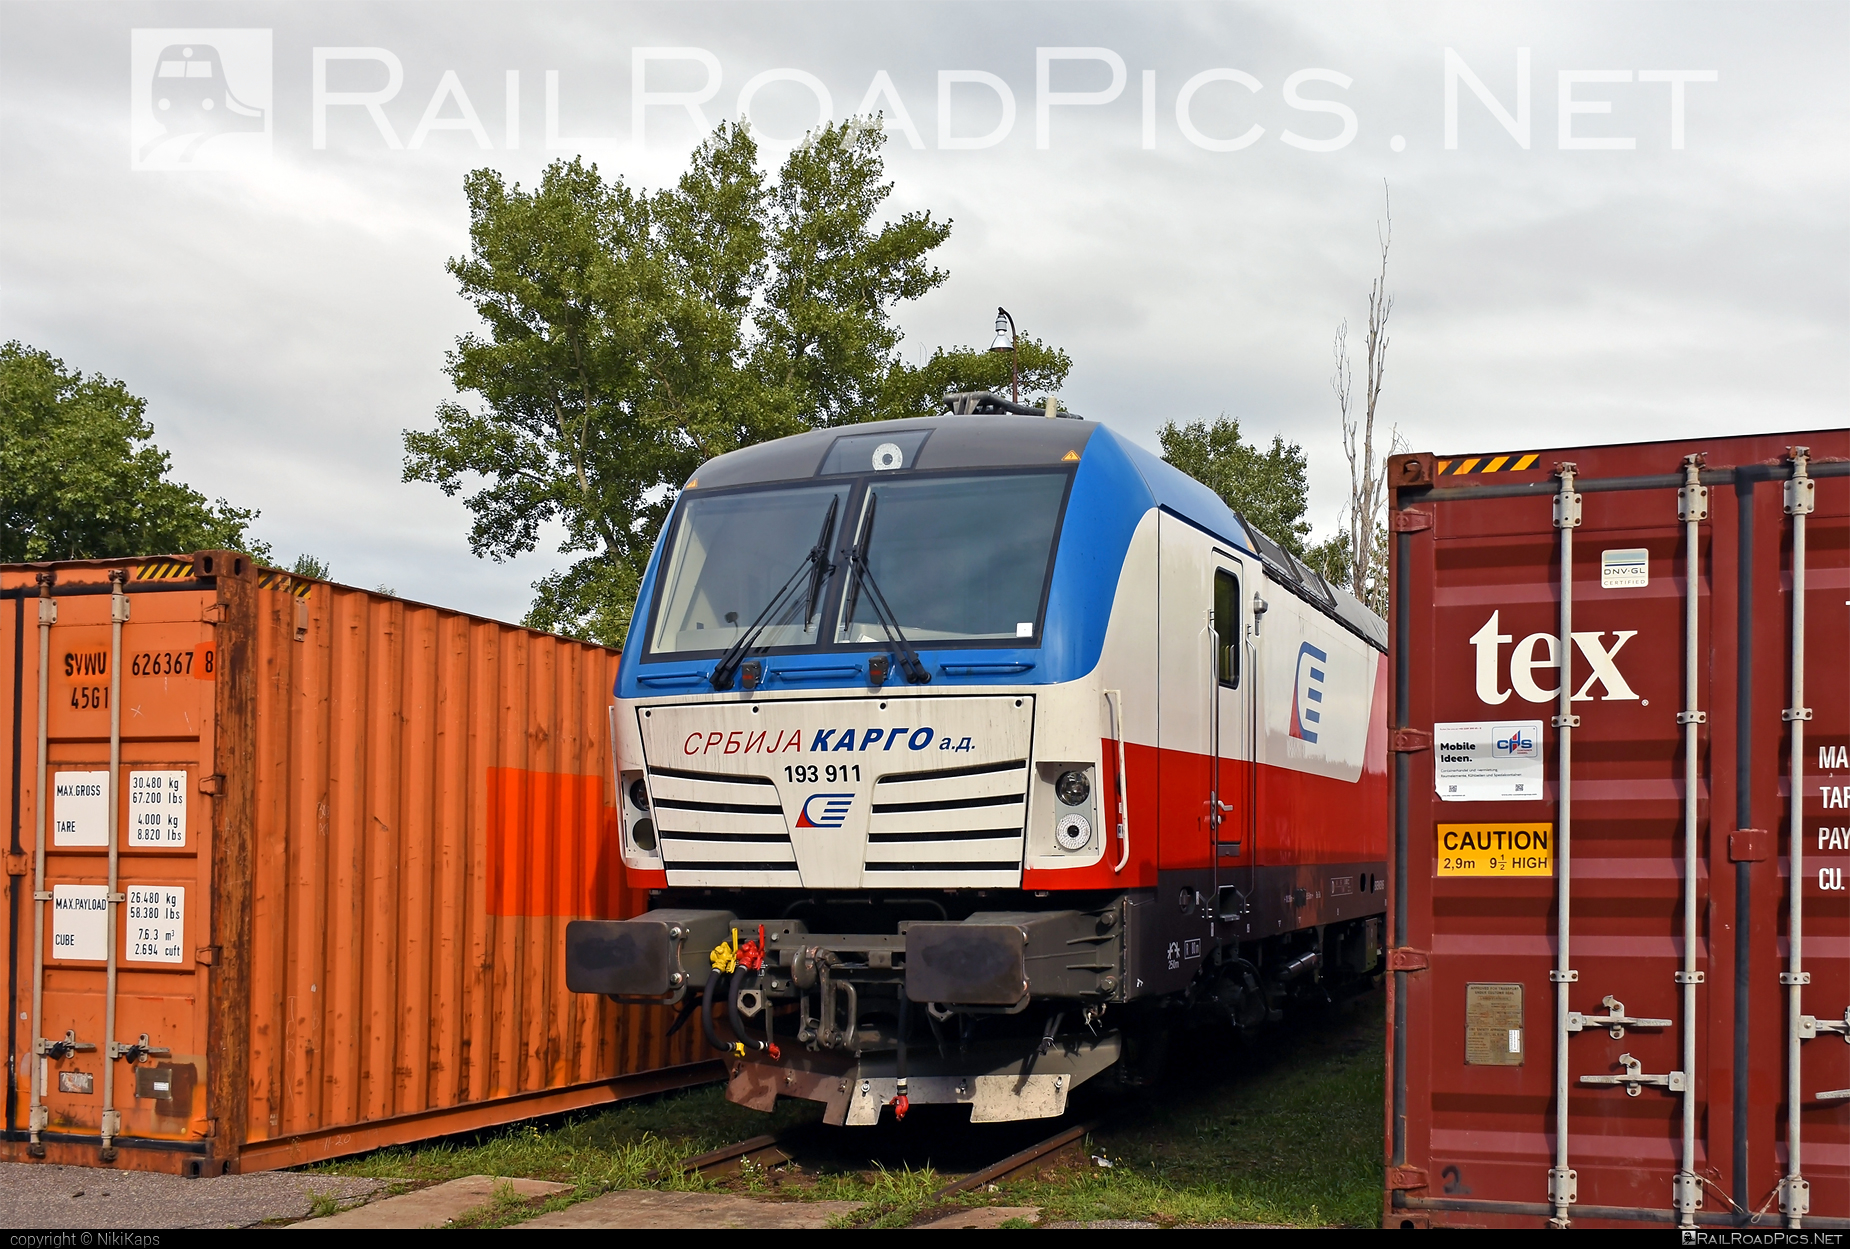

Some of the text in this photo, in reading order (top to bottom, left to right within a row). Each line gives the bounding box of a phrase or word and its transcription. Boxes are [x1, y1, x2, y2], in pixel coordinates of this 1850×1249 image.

[65, 650, 214, 676] SVWU 626367 8
[1469, 609, 1640, 705] tex
[71, 686, 109, 710] 45G1
[683, 726, 976, 756] СРБИЈА КАРГО а.д.
[1440, 742, 1476, 751] Mobile
[1440, 754, 1473, 763] Ideen.
[1819, 745, 1850, 769] MA
[784, 764, 861, 783] 193 911
[56, 784, 101, 797] MAX.GROSS
[132, 777, 179, 791] 30.480 kg
[132, 792, 183, 804] 67.200 lbs
[56, 820, 76, 833] TARE
[137, 813, 178, 828] 4.000 kg
[137, 829, 182, 841] 8.820 lbs
[1443, 830, 1548, 850] CAUTION
[1444, 857, 1476, 871] 2,9m
[1512, 857, 1548, 869] HIGH
[1818, 867, 1846, 890] CU.
[55, 898, 107, 911] MAX.PAYLOAD
[130, 892, 176, 907] 26.480 kg
[130, 907, 180, 920] 58.380 lbs
[55, 934, 75, 946] CUBE
[138, 928, 159, 941] 76.3
[135, 943, 181, 957] 2.694 cuft
